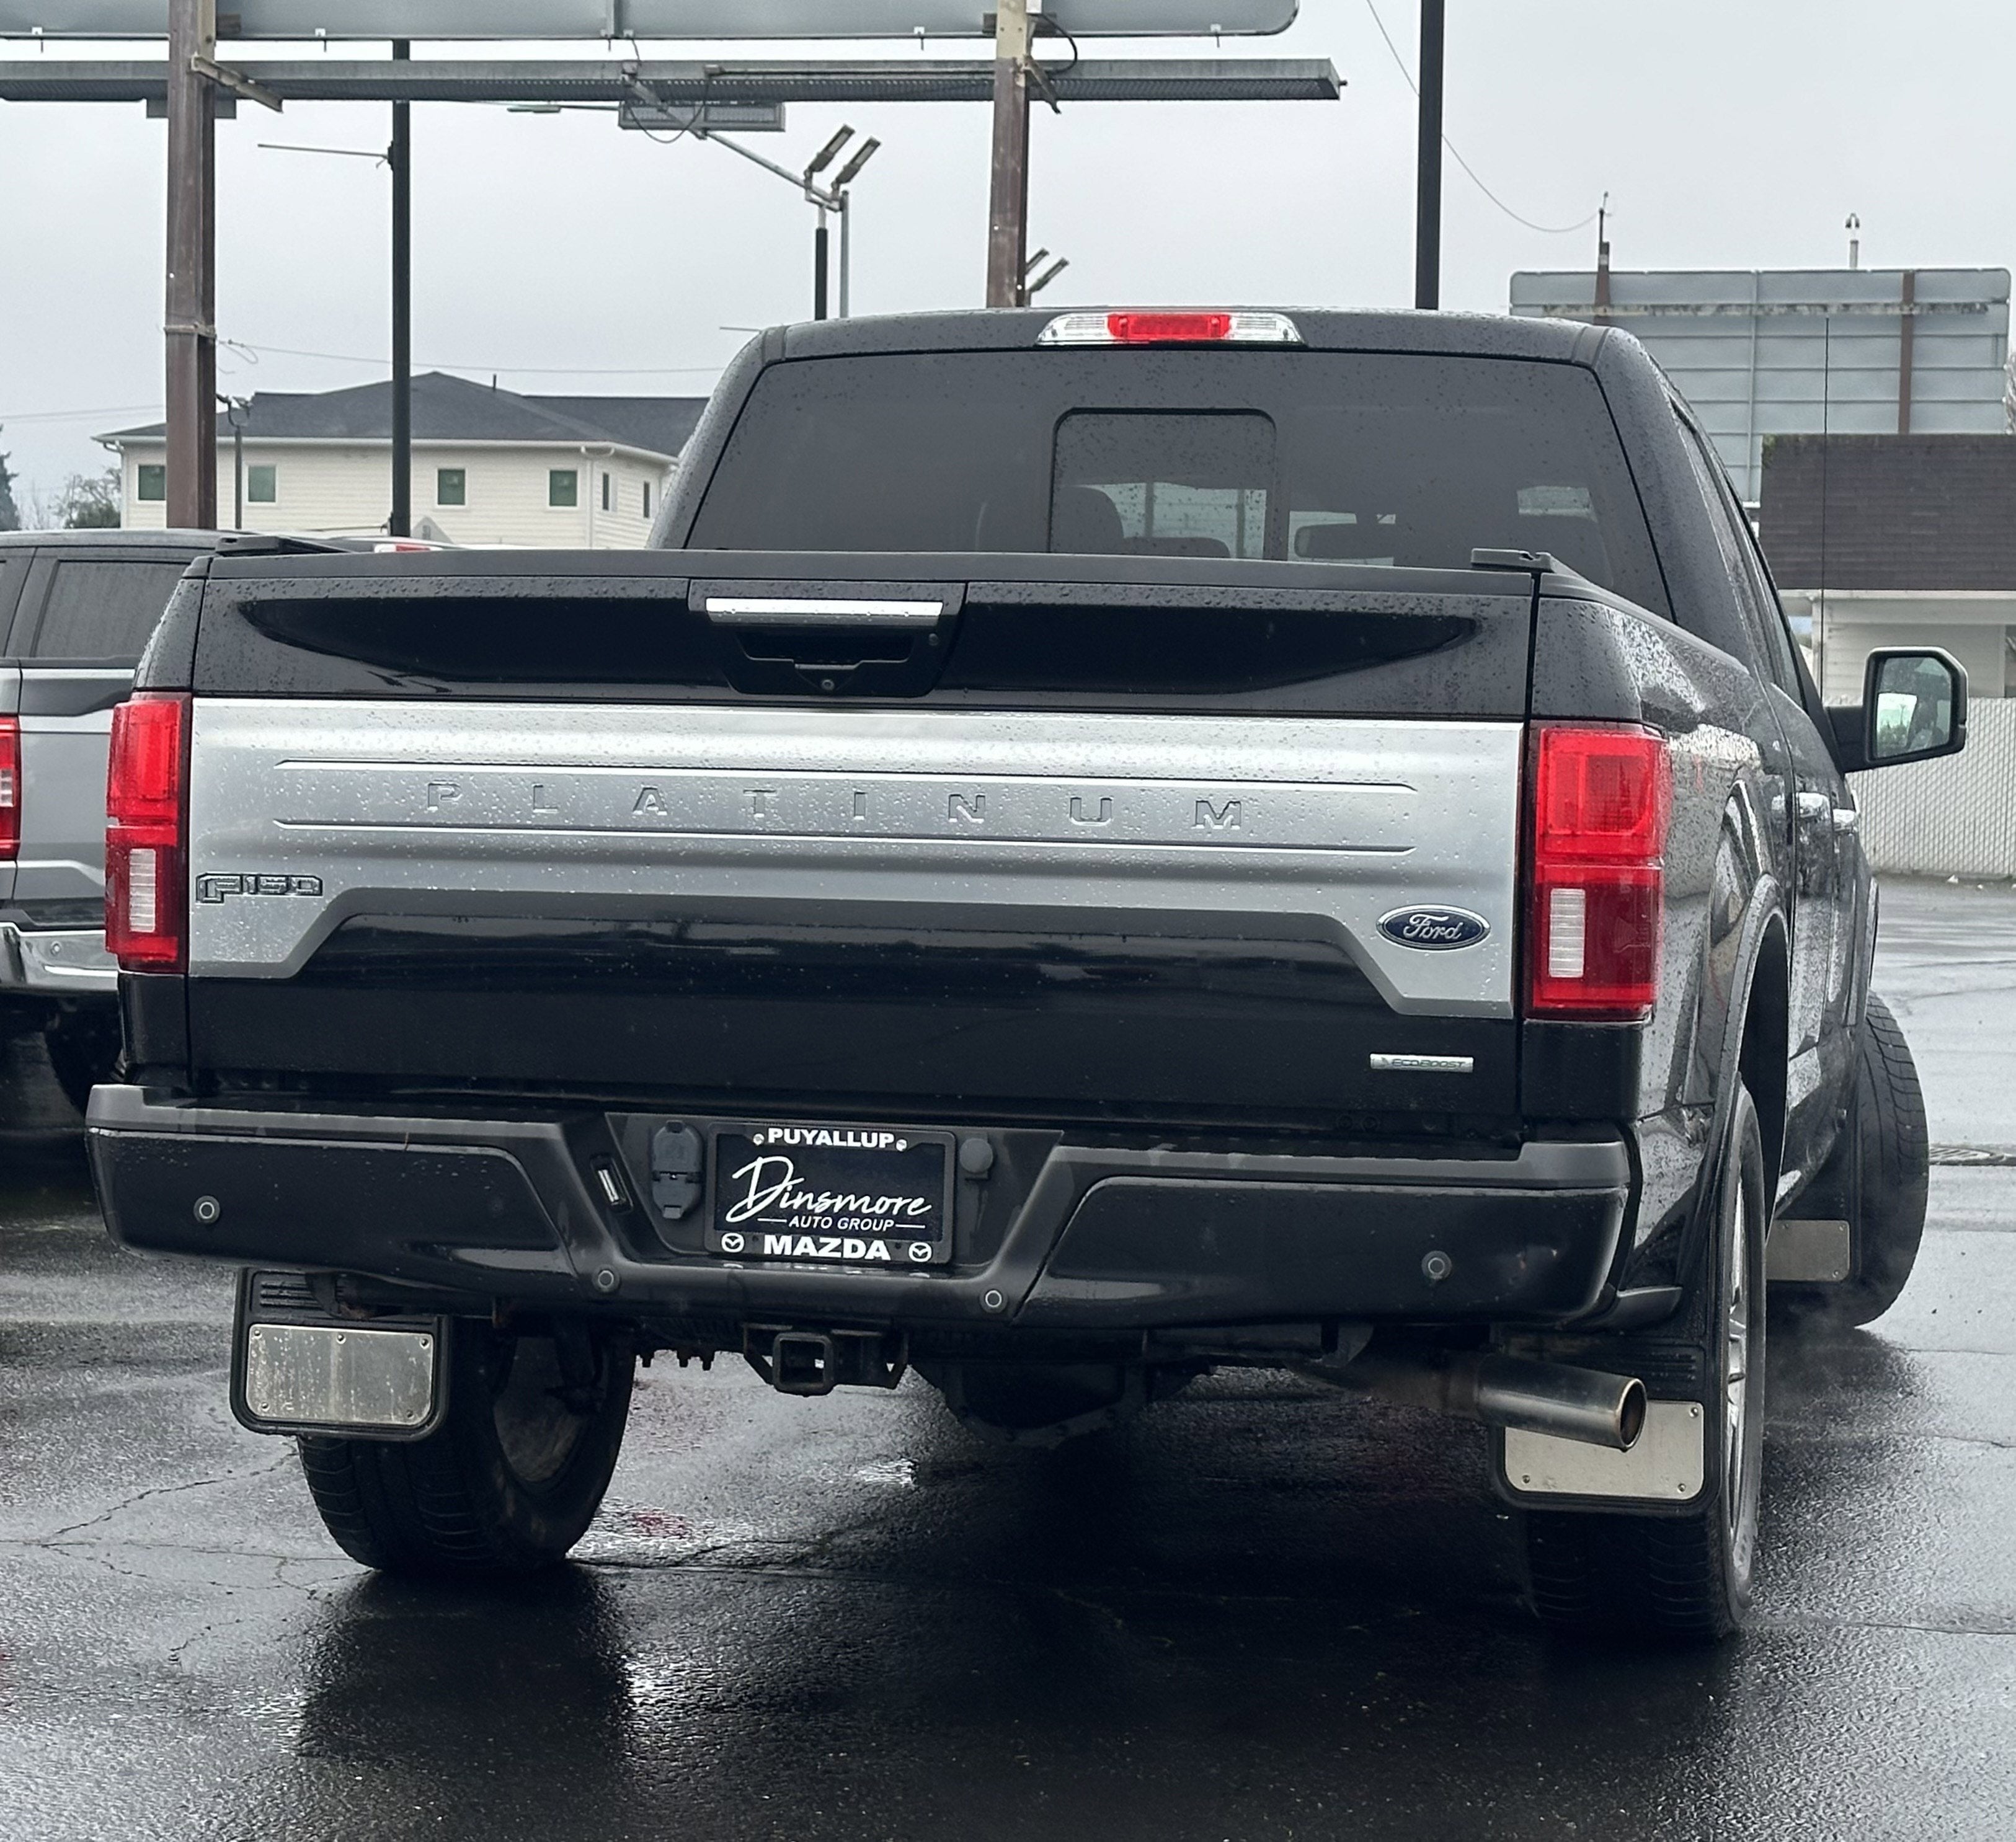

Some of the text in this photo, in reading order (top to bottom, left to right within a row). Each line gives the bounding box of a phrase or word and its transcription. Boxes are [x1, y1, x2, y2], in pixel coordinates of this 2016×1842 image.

[427, 781, 1242, 830] PLATINUM
[1403, 913, 1464, 939] Ford
[1392, 1058, 1466, 1068] ECOBOOST
[767, 1127, 895, 1149] PUYALLUP
[726, 1156, 932, 1223] Dinsmore
[788, 1215, 895, 1232] AUTO GROUP
[763, 1234, 891, 1261] MAZDA
